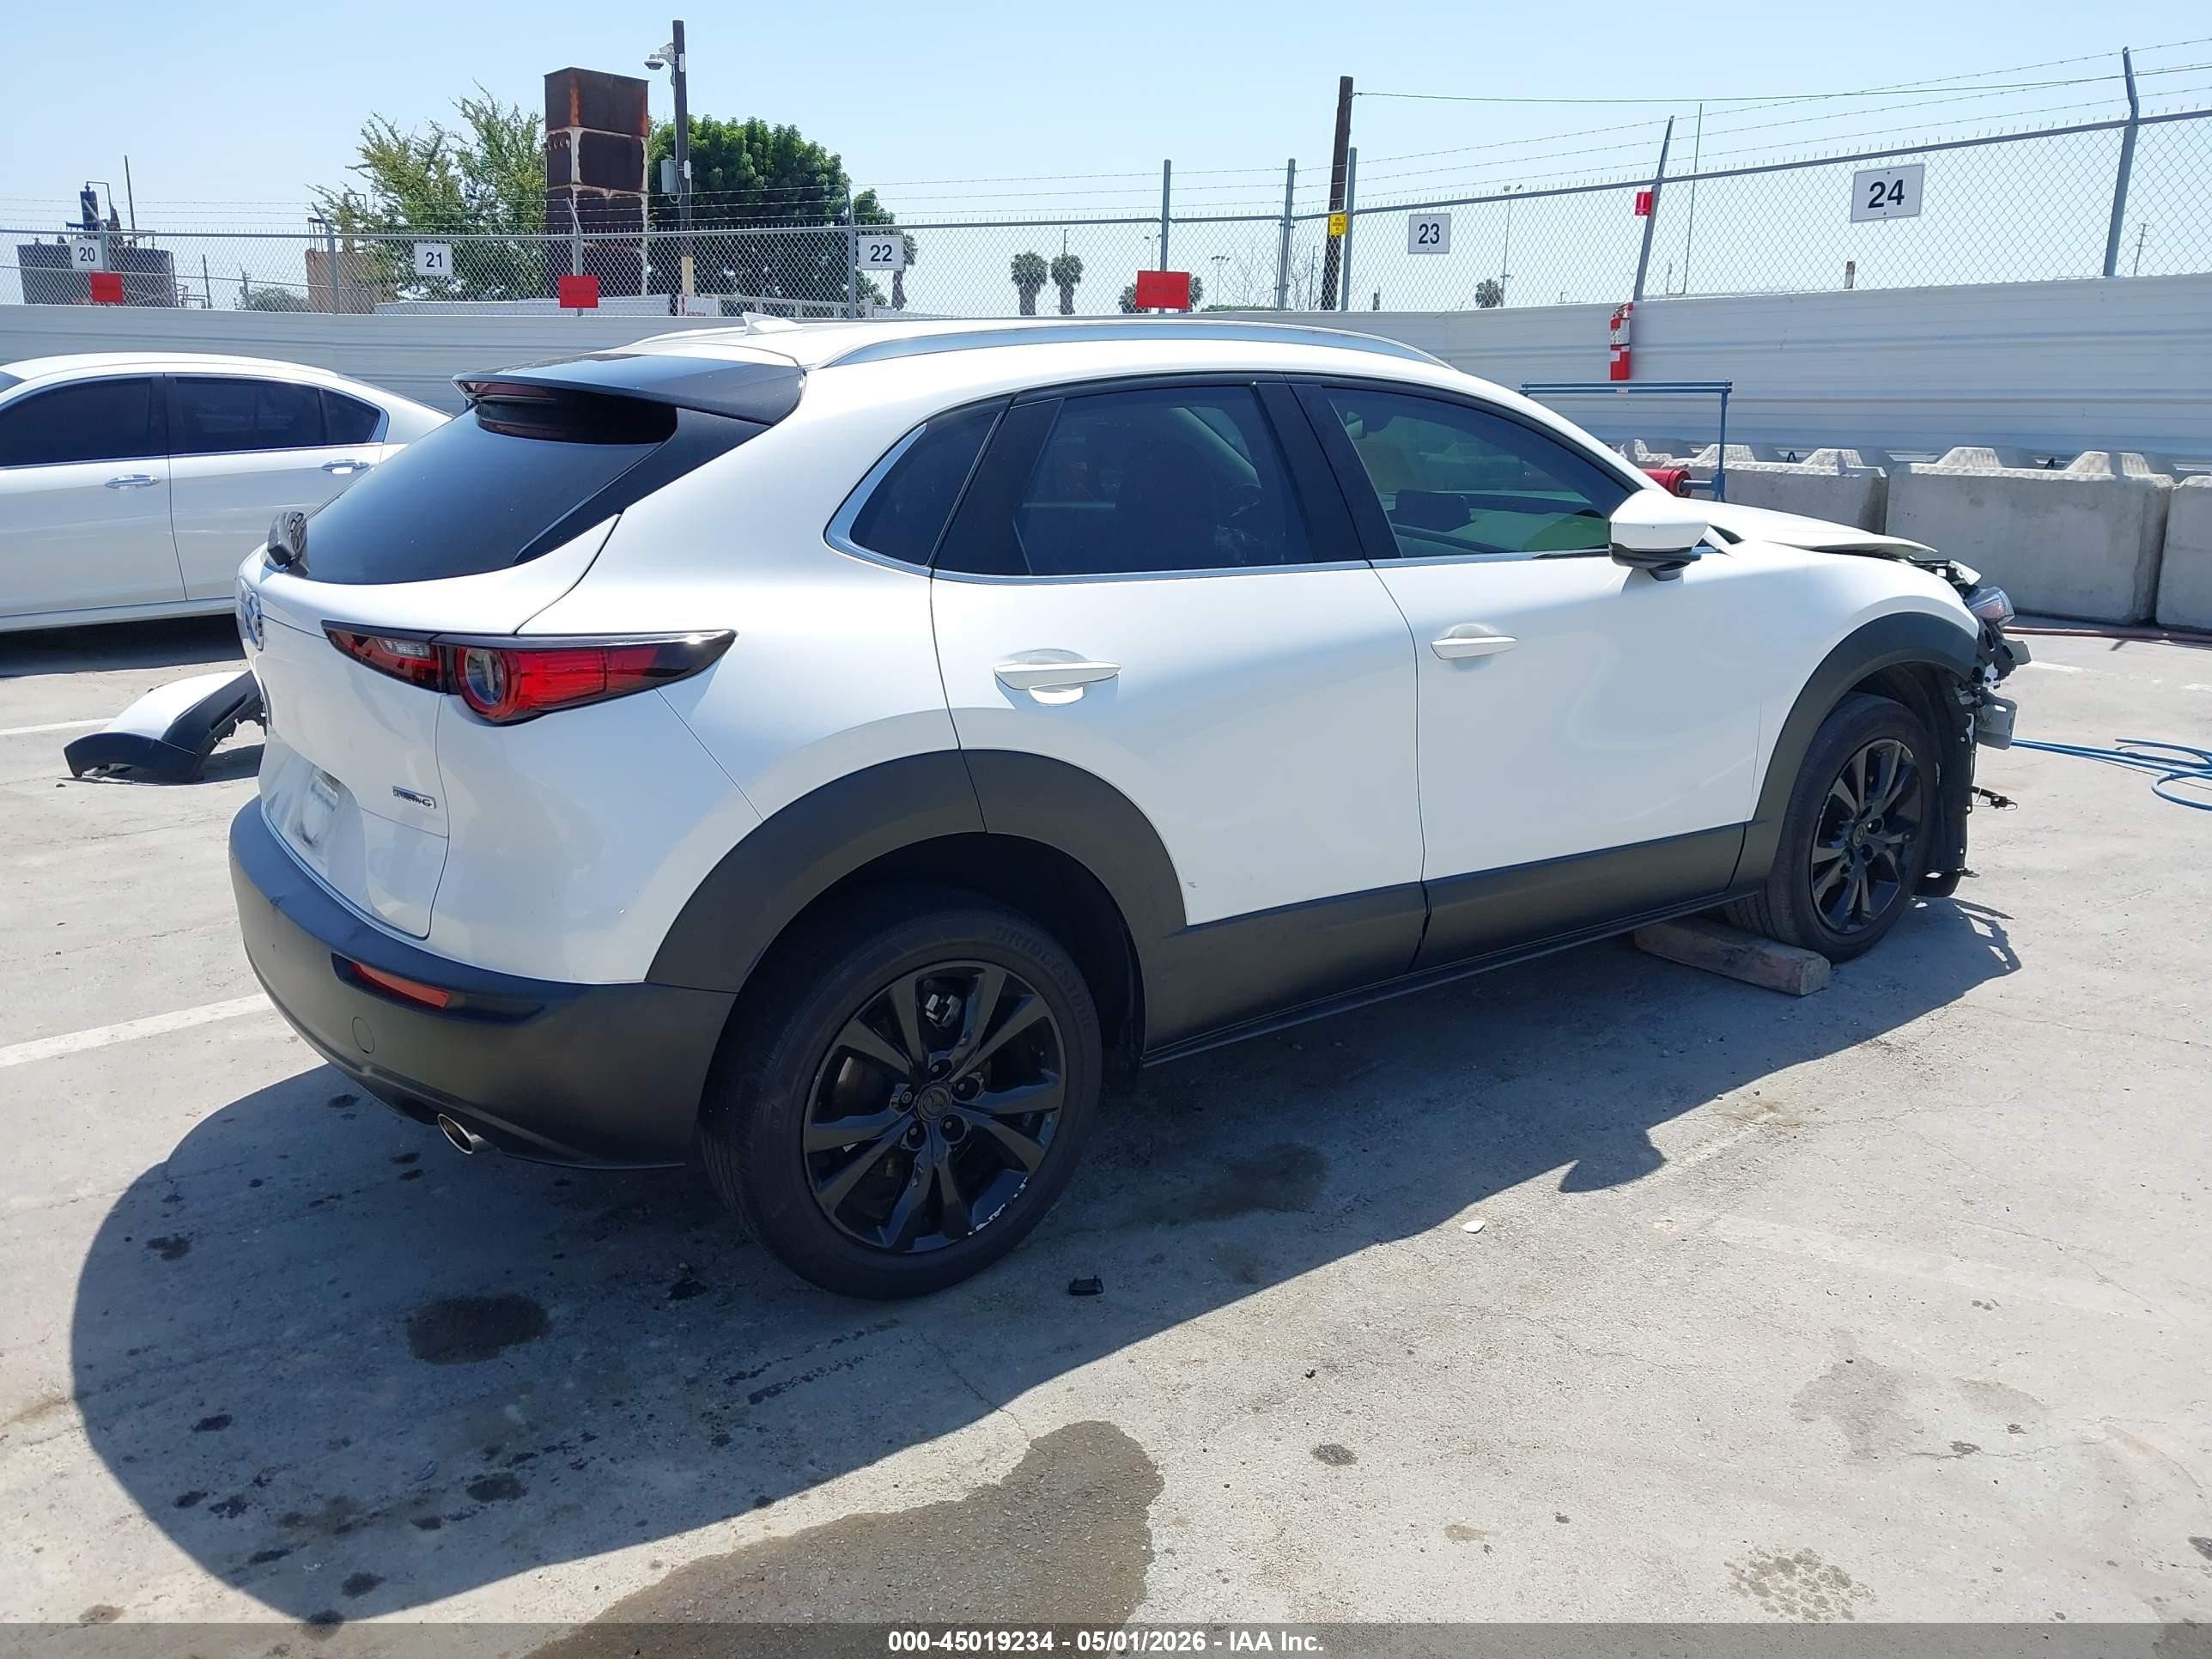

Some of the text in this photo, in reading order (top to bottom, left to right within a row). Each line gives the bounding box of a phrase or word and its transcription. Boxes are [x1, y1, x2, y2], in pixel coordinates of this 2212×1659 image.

[1868, 179, 1905, 209] 24
[1419, 222, 1440, 245] 23
[78, 246, 95, 262] 20
[425, 251, 442, 268] 21
[870, 244, 893, 262] 22
